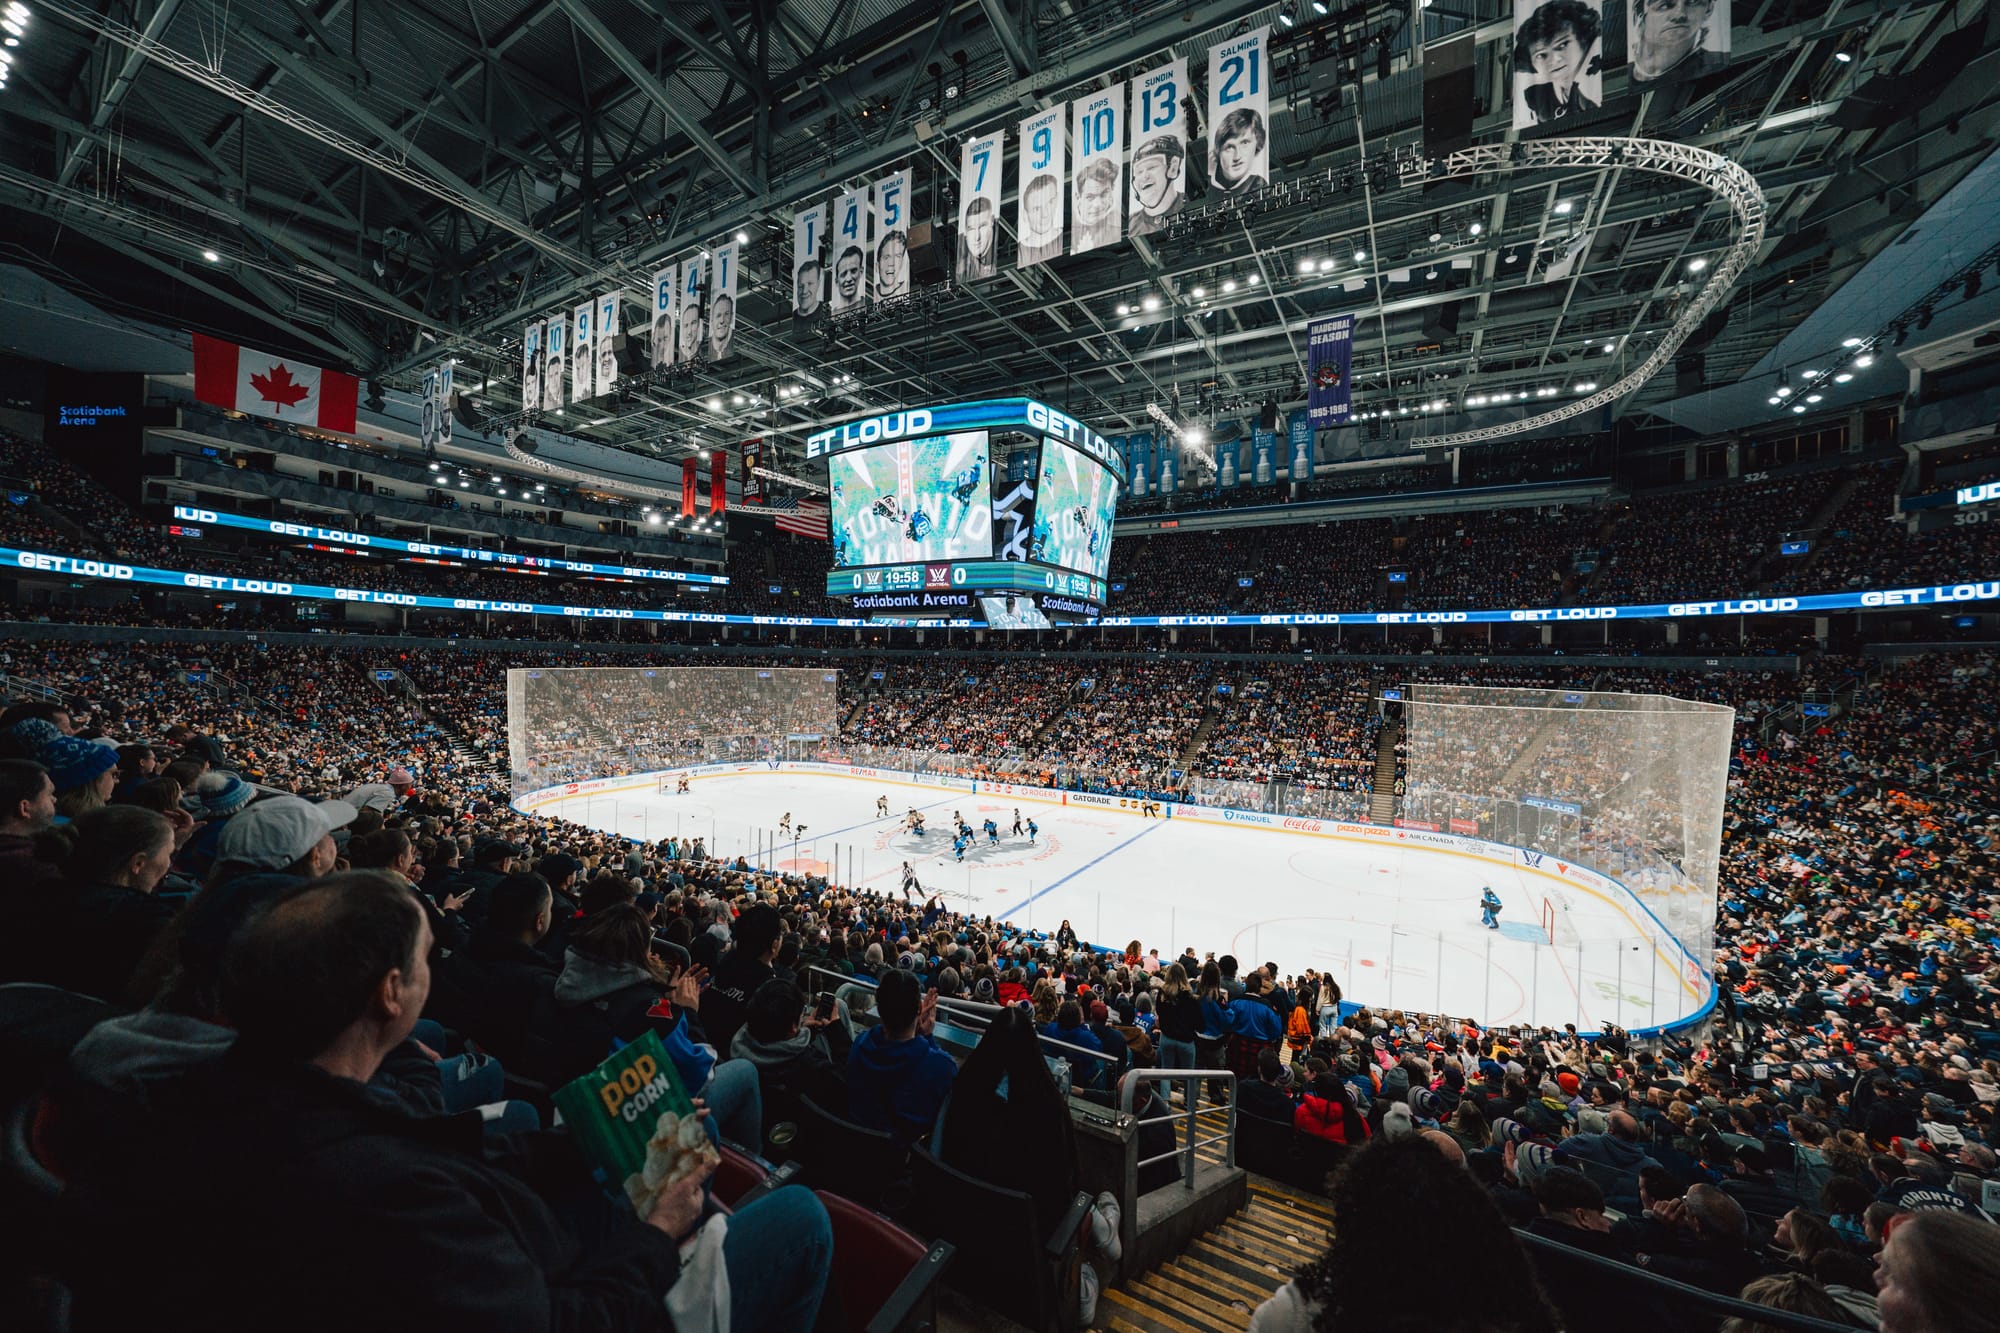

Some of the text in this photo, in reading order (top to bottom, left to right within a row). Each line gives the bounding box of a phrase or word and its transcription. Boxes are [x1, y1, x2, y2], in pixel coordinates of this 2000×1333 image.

[1220, 37, 1259, 58] SALMING
[1144, 70, 1174, 88] SUNDIN
[1219, 48, 1260, 107] 21
[1088, 98, 1109, 112] APPS
[1141, 81, 1177, 133] 13
[1027, 113, 1057, 132] KENNEDY
[1082, 107, 1115, 158] 10
[1032, 127, 1052, 170] 9
[972, 150, 991, 192] 7
[884, 188, 900, 227] 5
[842, 204, 858, 240] 4
[807, 222, 813, 256] 1
[721, 258, 728, 288] 1
[687, 268, 698, 297] 4
[658, 280, 670, 311] 6
[603, 303, 613, 333] 7
[579, 313, 588, 341] 9
[1311, 319, 1350, 335] INAUGURAL
[549, 325, 562, 353] 10
[1310, 329, 1350, 346] SEASON
[422, 375, 434, 400] 27
[441, 369, 450, 394] 17
[59, 406, 127, 416] Scotiabank
[59, 416, 96, 426] Arena
[843, 409, 933, 447] LOUD
[1026, 401, 1121, 470] GET LOUD
[1953, 511, 1989, 526] 301
[269, 520, 370, 545] GET LOUD
[407, 542, 442, 555] GET
[18, 551, 133, 581] GET LOUD
[623, 567, 686, 581] GET LOUD
[184, 573, 293, 595] GET LOUD
[853, 573, 862, 589] 0
[885, 571, 920, 584] 19:58
[953, 567, 967, 584] 0
[1045, 572, 1054, 588] 0
[334, 588, 417, 605] GET LOUD
[853, 593, 968, 608] Scotiabank Arena
[1860, 588, 1927, 606] GET
[453, 599, 534, 613] GET LOUD
[563, 606, 634, 619] GET LOUD
[1041, 595, 1099, 617] Scotiabank Arena
[1510, 607, 1617, 621] GET LOUD
[1668, 599, 1798, 616] GET LOUD
[662, 612, 727, 623] GET LOUD
[752, 616, 812, 626] GET LOUD
[837, 619, 862, 627] GET
[917, 619, 939, 627] GET
[1159, 616, 1228, 625] GET LOUD
[1260, 614, 1339, 624] GET LOUD
[1376, 612, 1467, 623] GET LOUD
[850, 767, 877, 777] RE/MAX
[1029, 788, 1057, 799] ROGERS
[1073, 794, 1111, 805] GATORADE
[1526, 799, 1575, 814] GET LOUD
[1235, 813, 1272, 824] FANDUEL
[1336, 823, 1391, 838] pizza pizza
[1408, 833, 1422, 841] AIR
[1422, 835, 1455, 846] CANADA
[600, 1054, 657, 1118] POP
[622, 1072, 671, 1122] CORN
[1899, 1189, 1965, 1209] TORONTO
